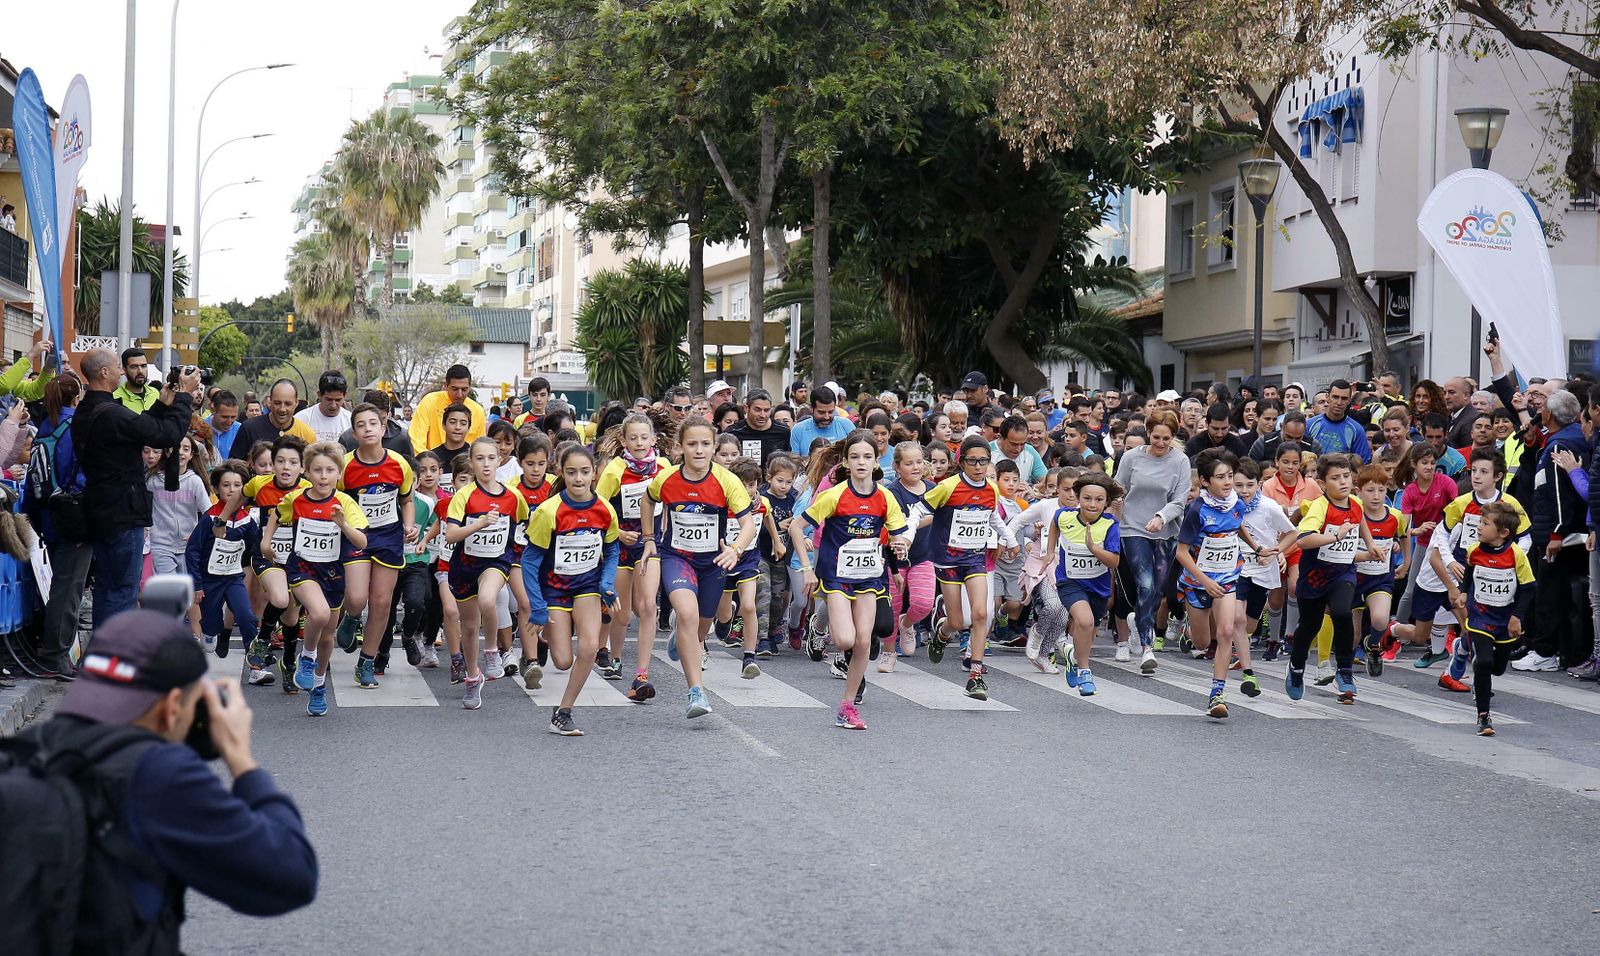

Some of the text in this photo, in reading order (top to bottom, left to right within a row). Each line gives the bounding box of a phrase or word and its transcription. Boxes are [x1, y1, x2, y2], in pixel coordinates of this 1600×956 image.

[630, 498, 642, 509] 20
[365, 503, 391, 518] 2162
[679, 527, 710, 540] 2201
[847, 526, 875, 536] Málaga
[957, 526, 986, 537] 2016
[302, 536, 335, 550] 2161
[472, 533, 503, 546] 2140
[270, 542, 292, 553] 208
[1328, 541, 1355, 552] 2202
[563, 549, 597, 563] 2152
[845, 555, 877, 567] 2156
[1206, 550, 1234, 562] 2145
[1071, 558, 1102, 569] 2014
[1480, 581, 1510, 595] 2144
